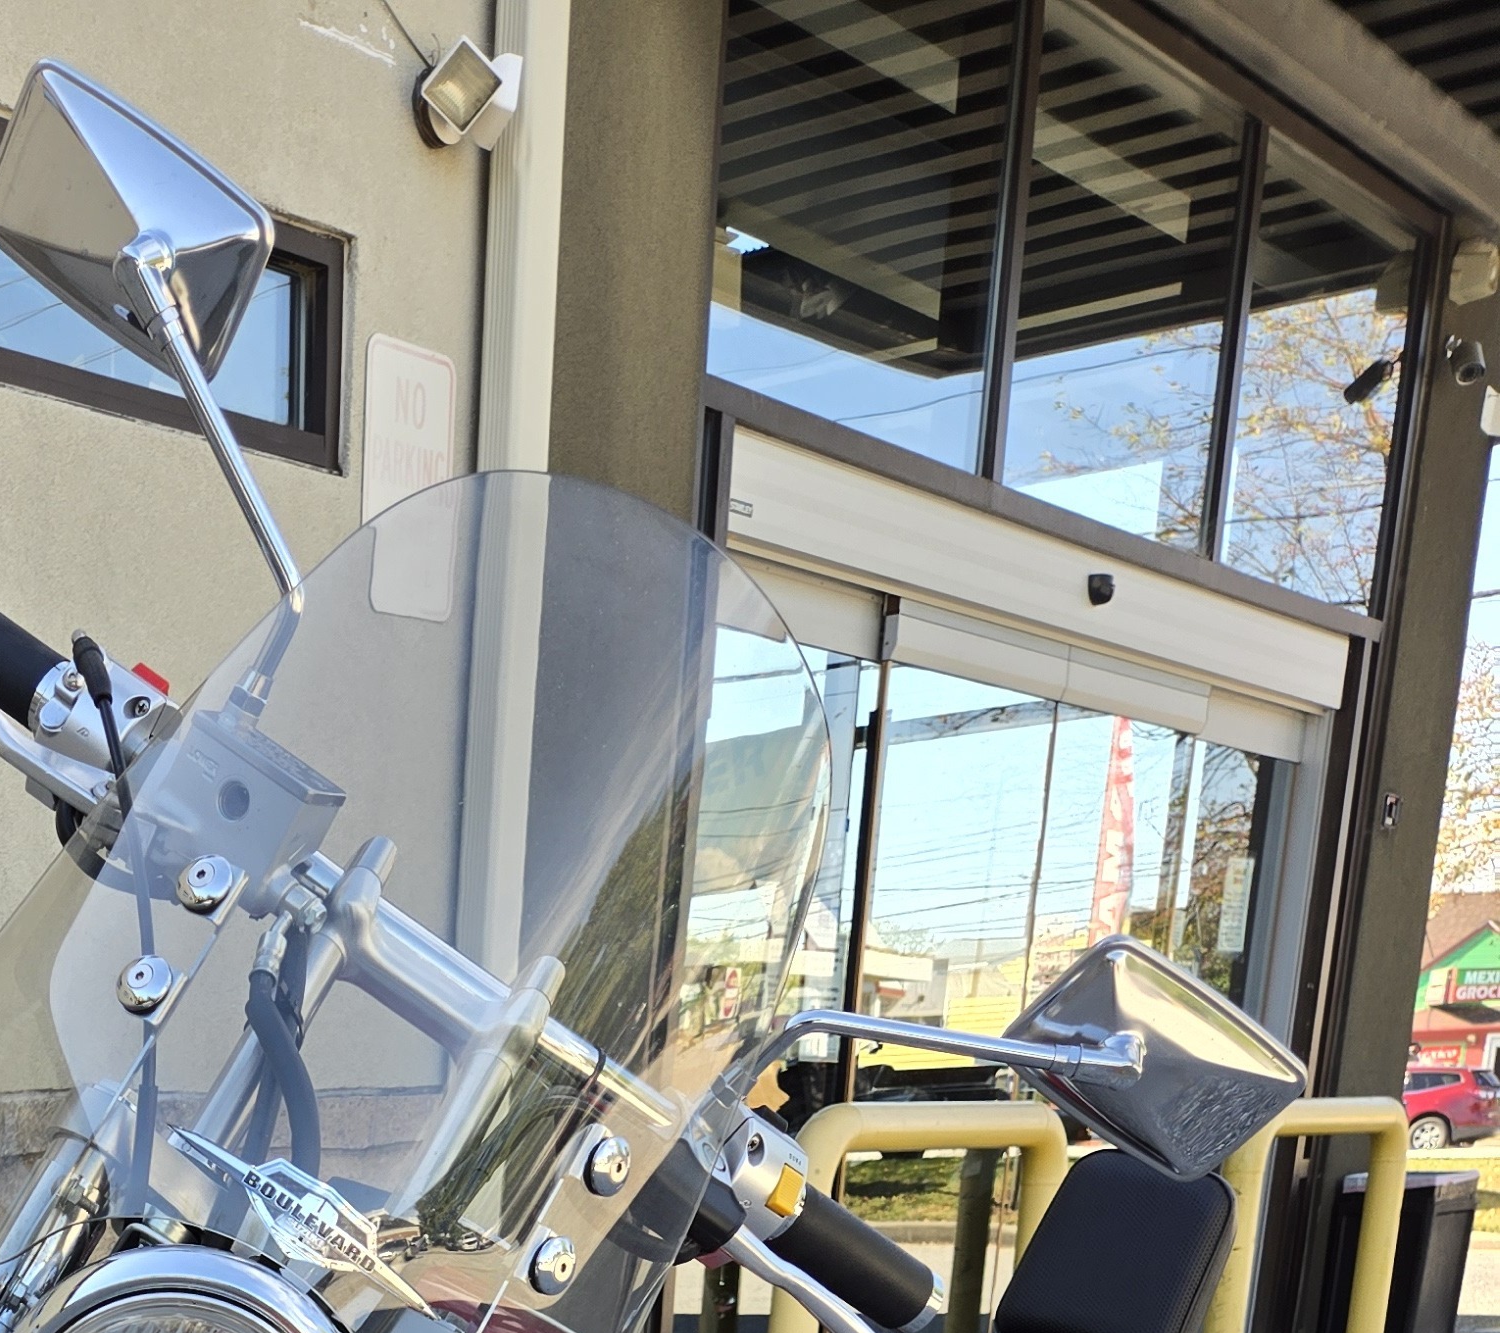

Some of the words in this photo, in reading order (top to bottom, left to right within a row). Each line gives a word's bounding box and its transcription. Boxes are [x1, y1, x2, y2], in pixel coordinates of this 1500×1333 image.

[396, 377, 426, 430] NO
[371, 435, 447, 489] PARKING
[243, 1170, 376, 1273] BOULEVARD
